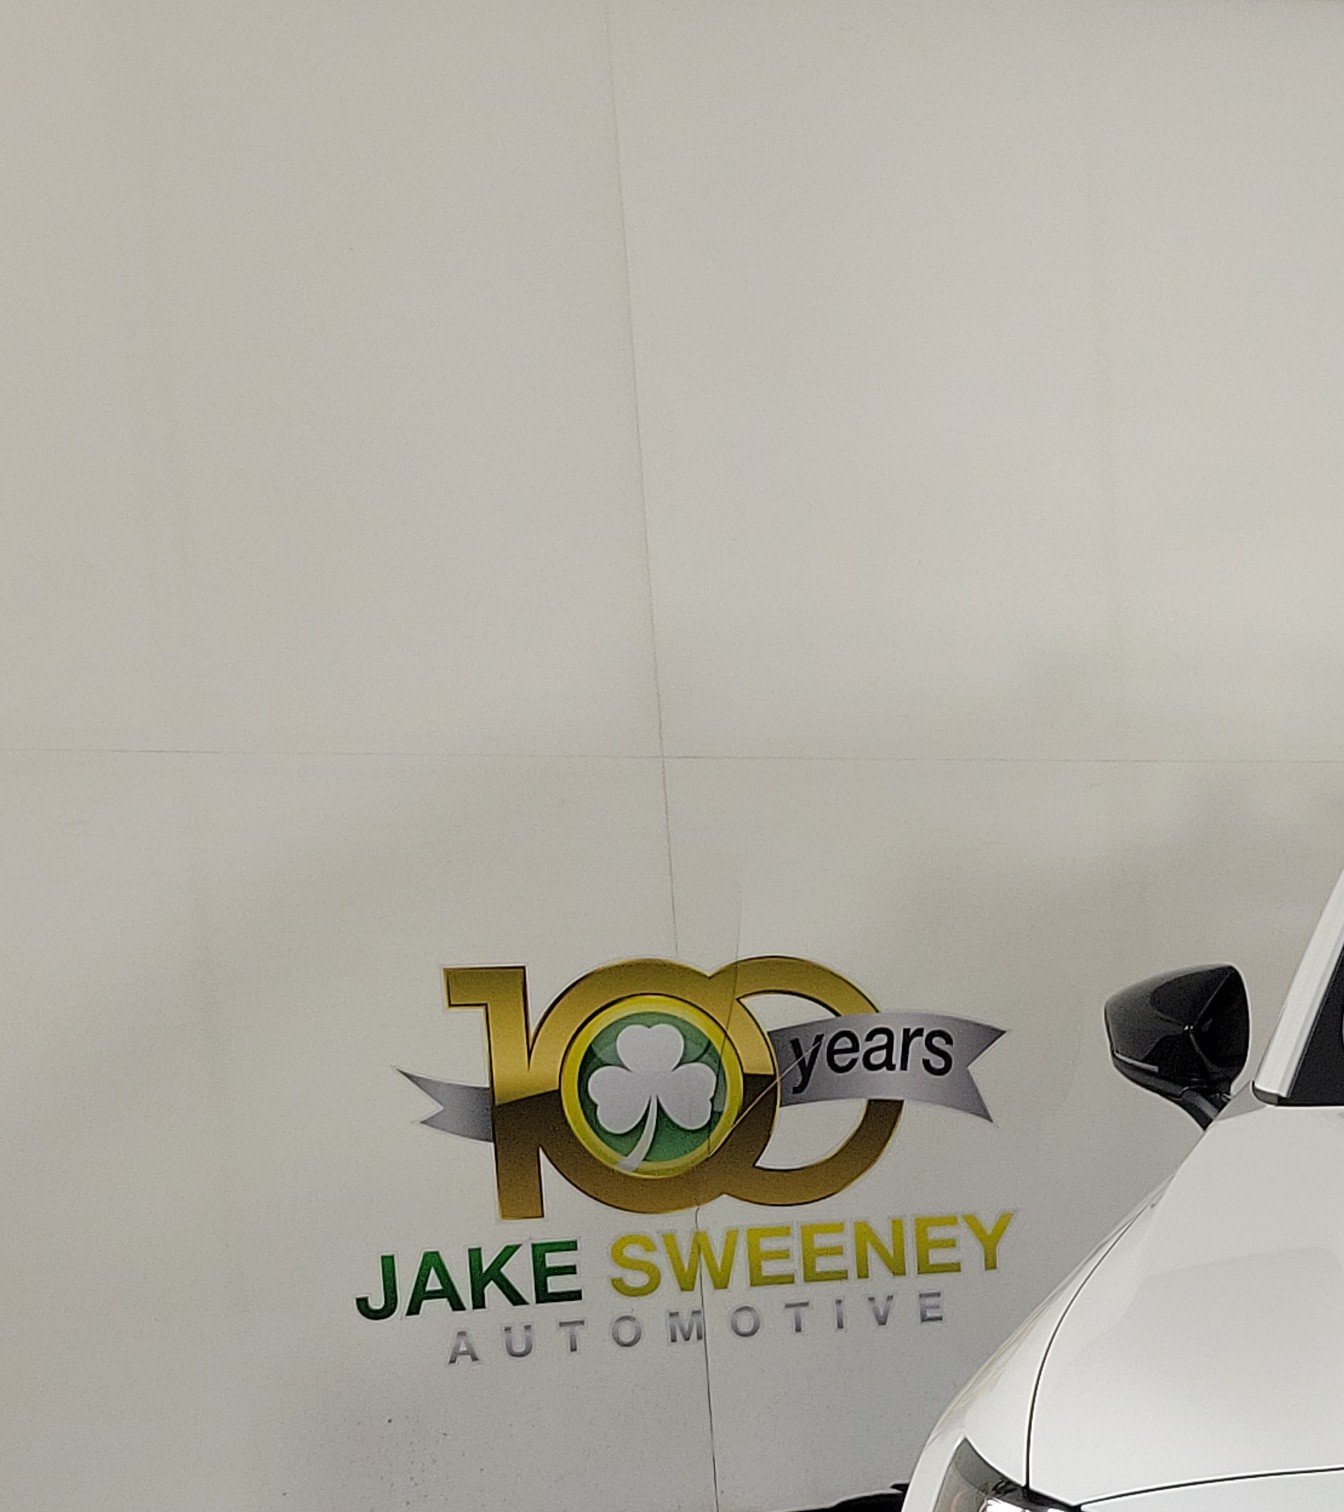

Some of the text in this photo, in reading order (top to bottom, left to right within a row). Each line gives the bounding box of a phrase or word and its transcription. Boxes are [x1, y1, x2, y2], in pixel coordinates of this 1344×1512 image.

[444, 955, 954, 1220] 100 years
[356, 1211, 1014, 1321] JAKE SWEENEY
[447, 1292, 944, 1365] AUTOMOTIVE
